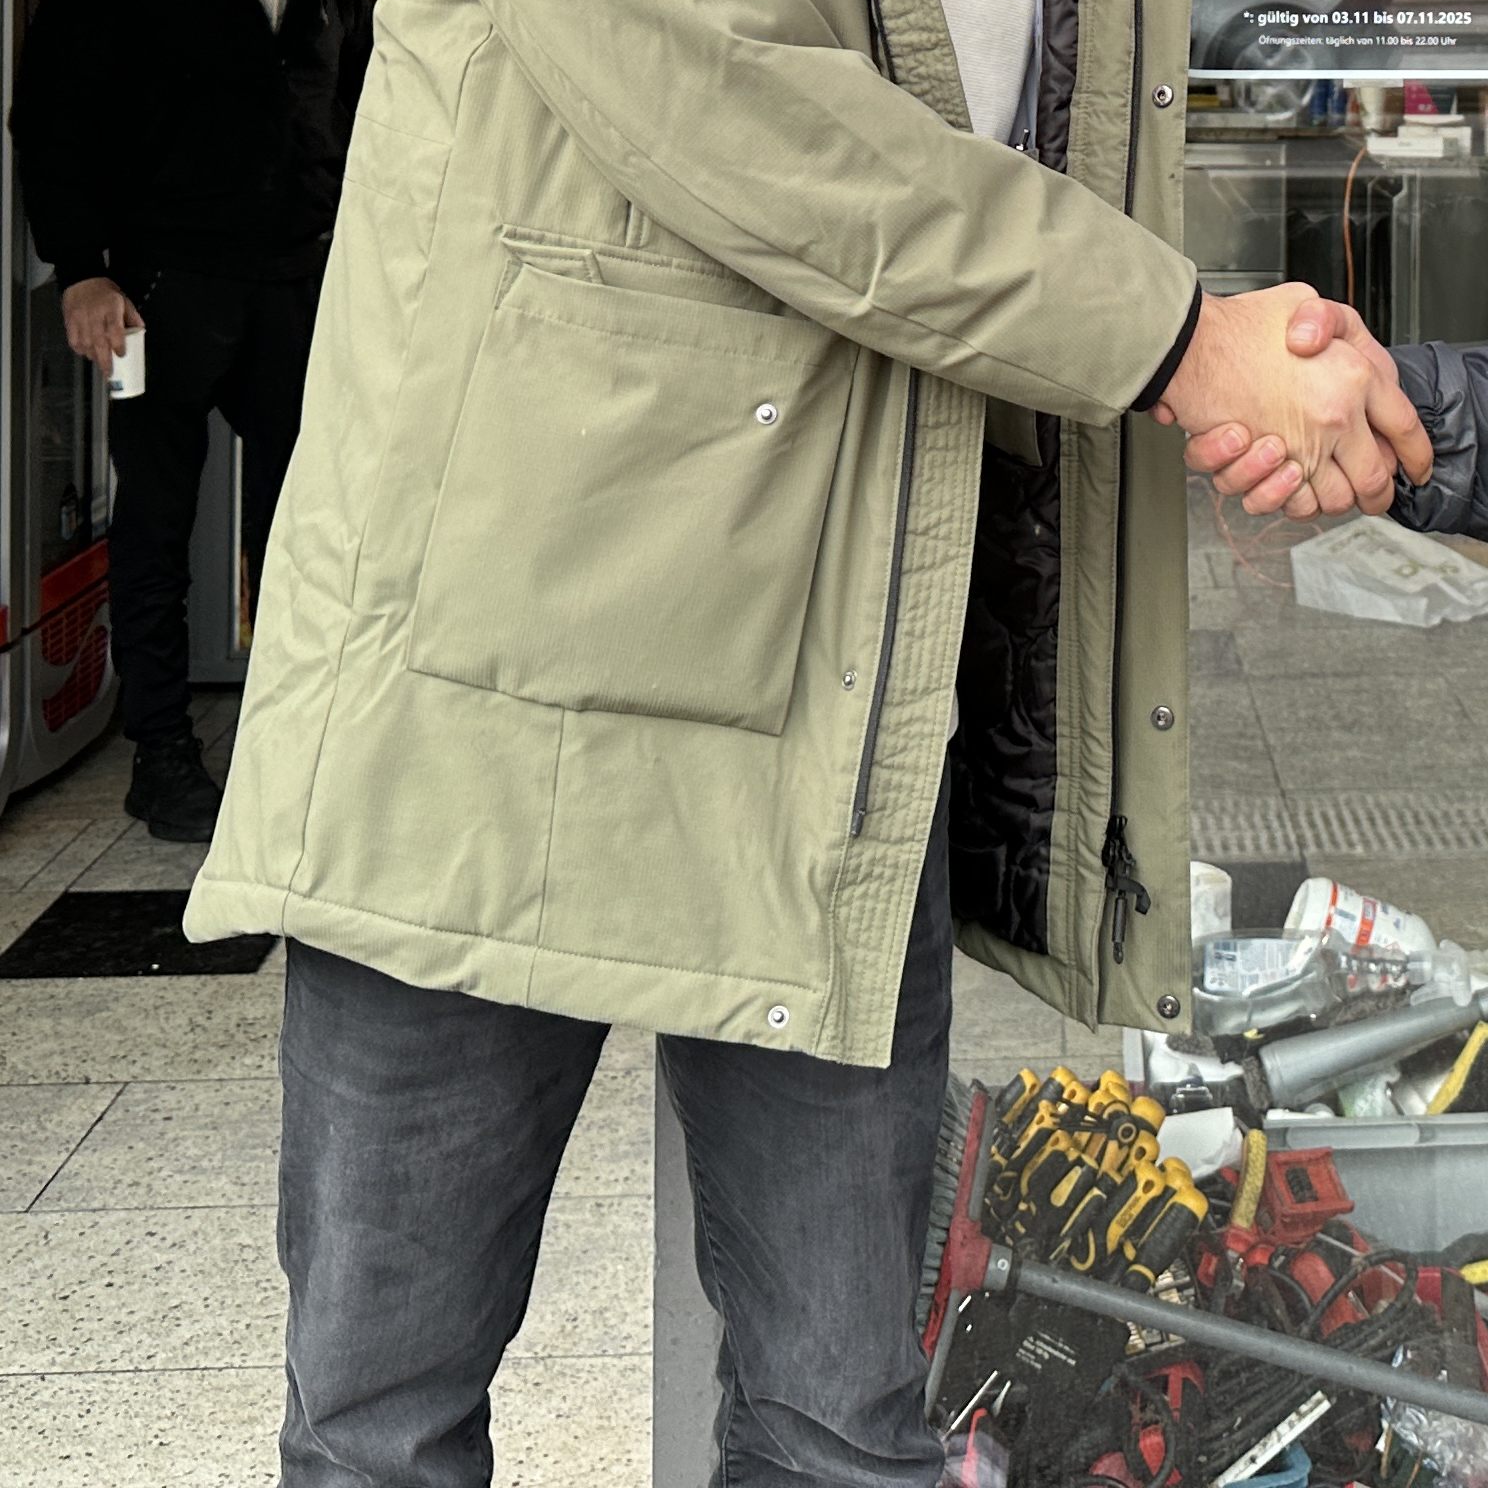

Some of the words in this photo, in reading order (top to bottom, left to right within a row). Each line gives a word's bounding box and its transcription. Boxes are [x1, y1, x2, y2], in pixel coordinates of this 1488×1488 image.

[1258, 10, 1299, 27] gültig
[1302, 14, 1328, 24] von
[1331, 12, 1369, 24] 03.11
[1373, 11, 1394, 24] bis
[1396, 12, 1472, 25] 07.11.2025
[1325, 35, 1355, 48] täglich
[1356, 37, 1373, 46] von
[1400, 36, 1413, 46] bis
[1441, 36, 1457, 46] Uhr
